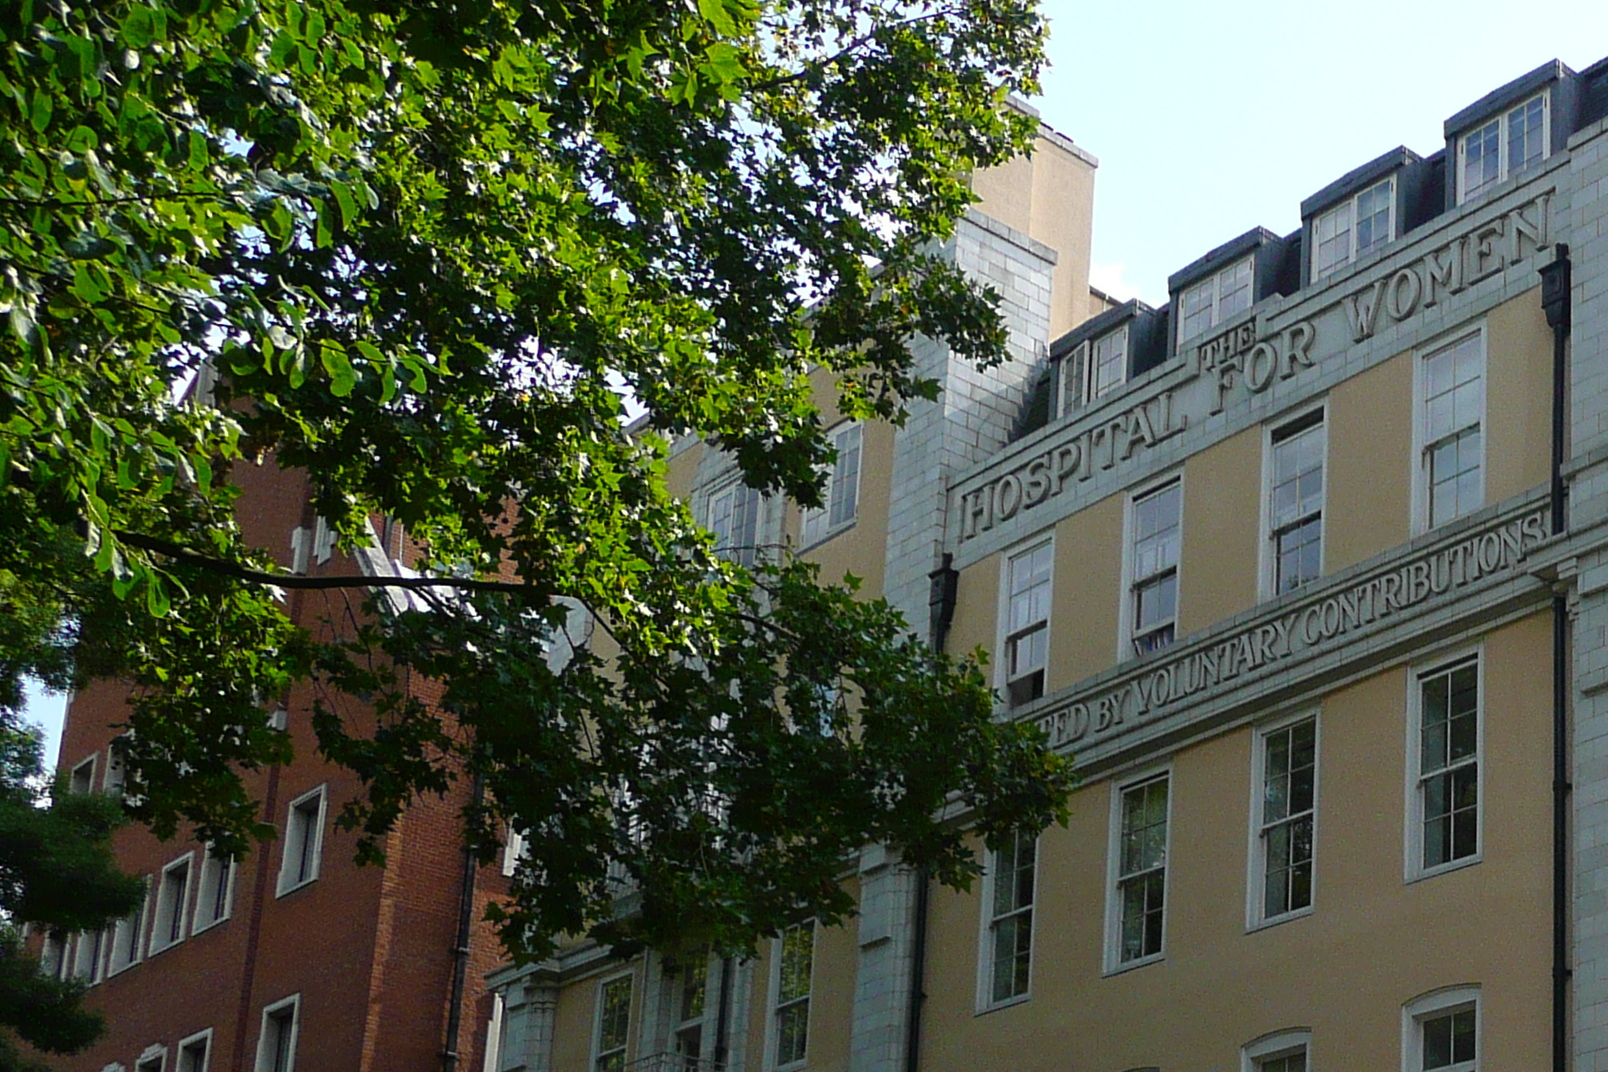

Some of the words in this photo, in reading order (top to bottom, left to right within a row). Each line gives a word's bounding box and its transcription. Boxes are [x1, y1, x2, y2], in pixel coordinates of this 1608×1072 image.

[957, 393, 1188, 544] HOSPITAL
[1209, 320, 1316, 417] FOR
[1342, 195, 1551, 343] WOMEN
[1199, 320, 1257, 372] THE
[1094, 685, 1132, 733] BY
[1130, 611, 1299, 715] VOLUNTARY
[1304, 511, 1547, 645] CONTRIBUTIONS
